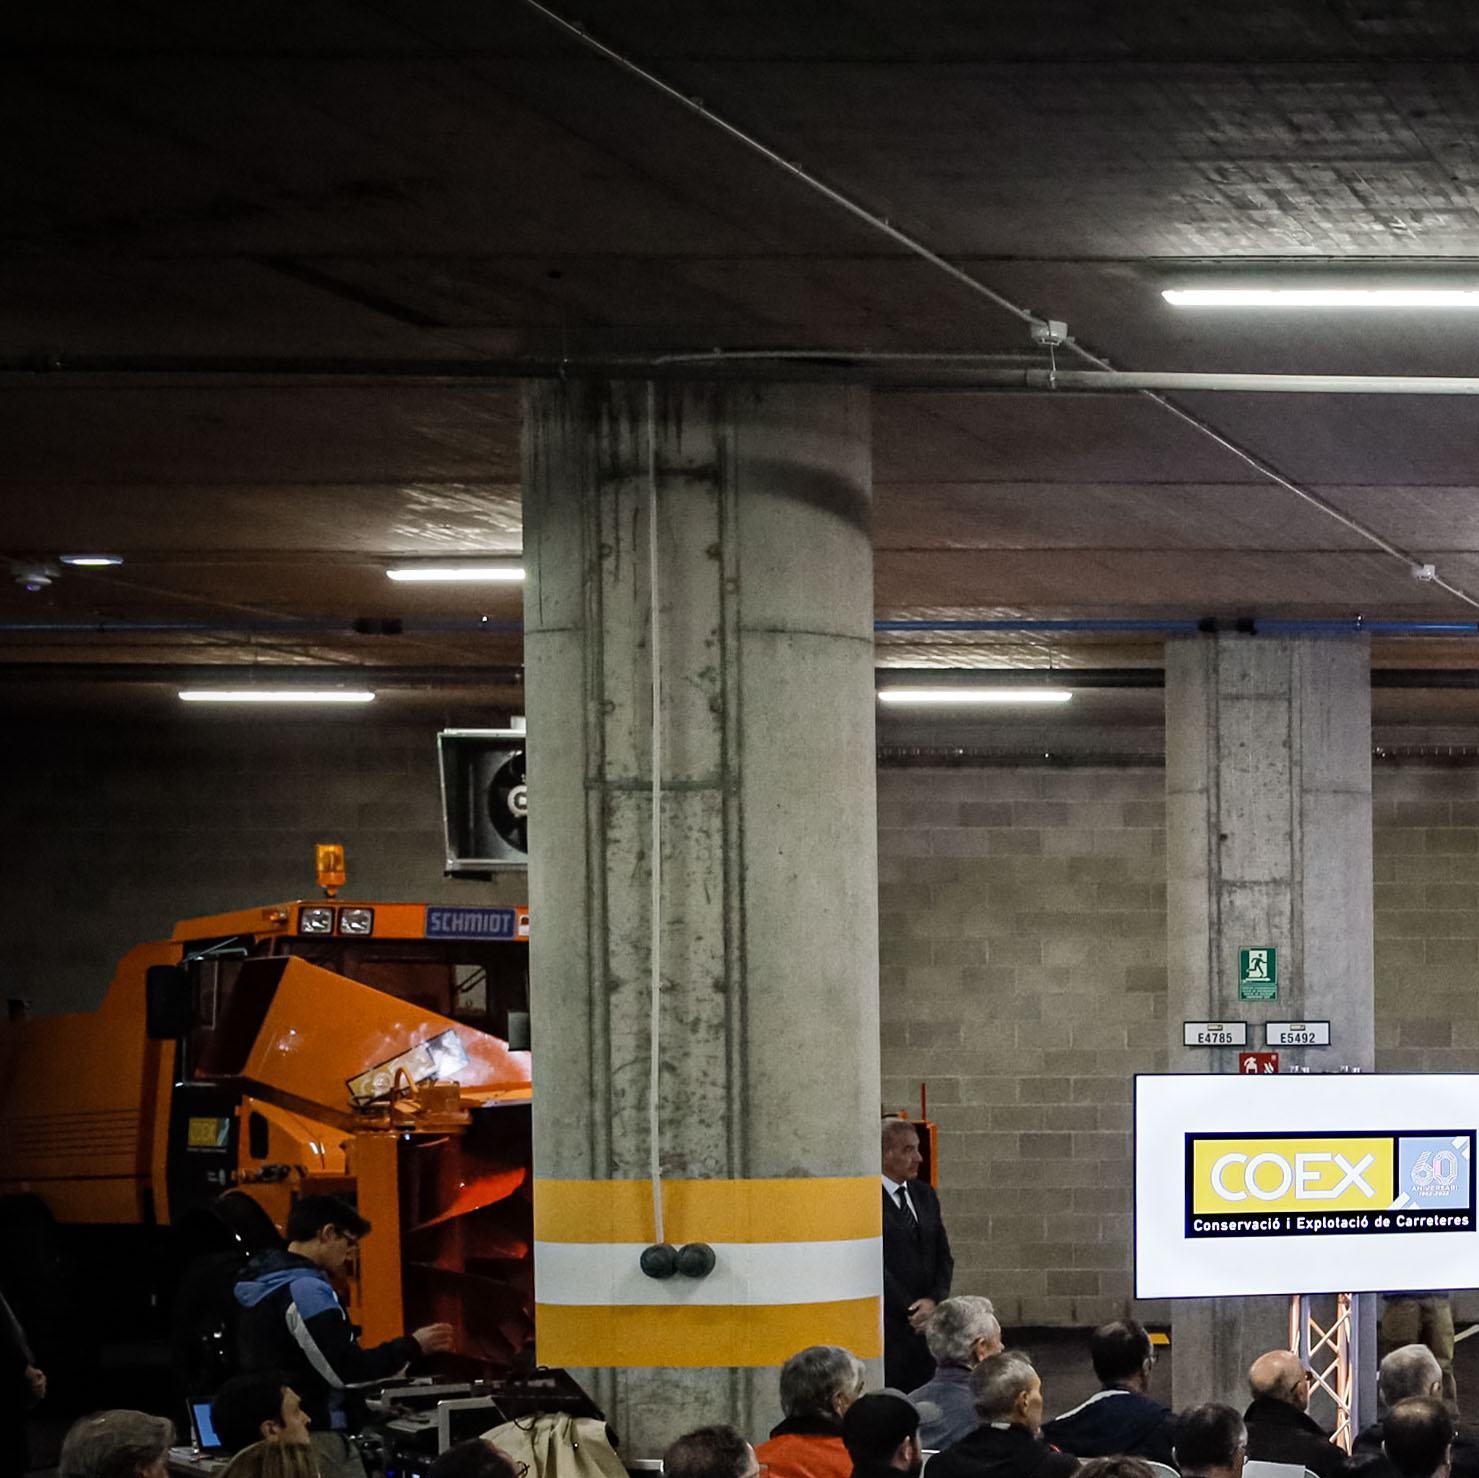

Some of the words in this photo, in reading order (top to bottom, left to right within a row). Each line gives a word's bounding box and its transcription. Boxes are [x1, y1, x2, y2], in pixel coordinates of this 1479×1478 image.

[431, 911, 512, 933] SCHMIDT
[1198, 1033, 1233, 1044] E4785
[1280, 1032, 1316, 1044] E5492
[1210, 1152, 1376, 1202] COEX
[1411, 1150, 1458, 1186] 60
[1193, 1217, 1281, 1232] Conservació
[1286, 1217, 1291, 1230] i
[1296, 1215, 1369, 1232] Explotació
[1374, 1215, 1391, 1228] de
[1396, 1214, 1470, 1227] Carreteres
